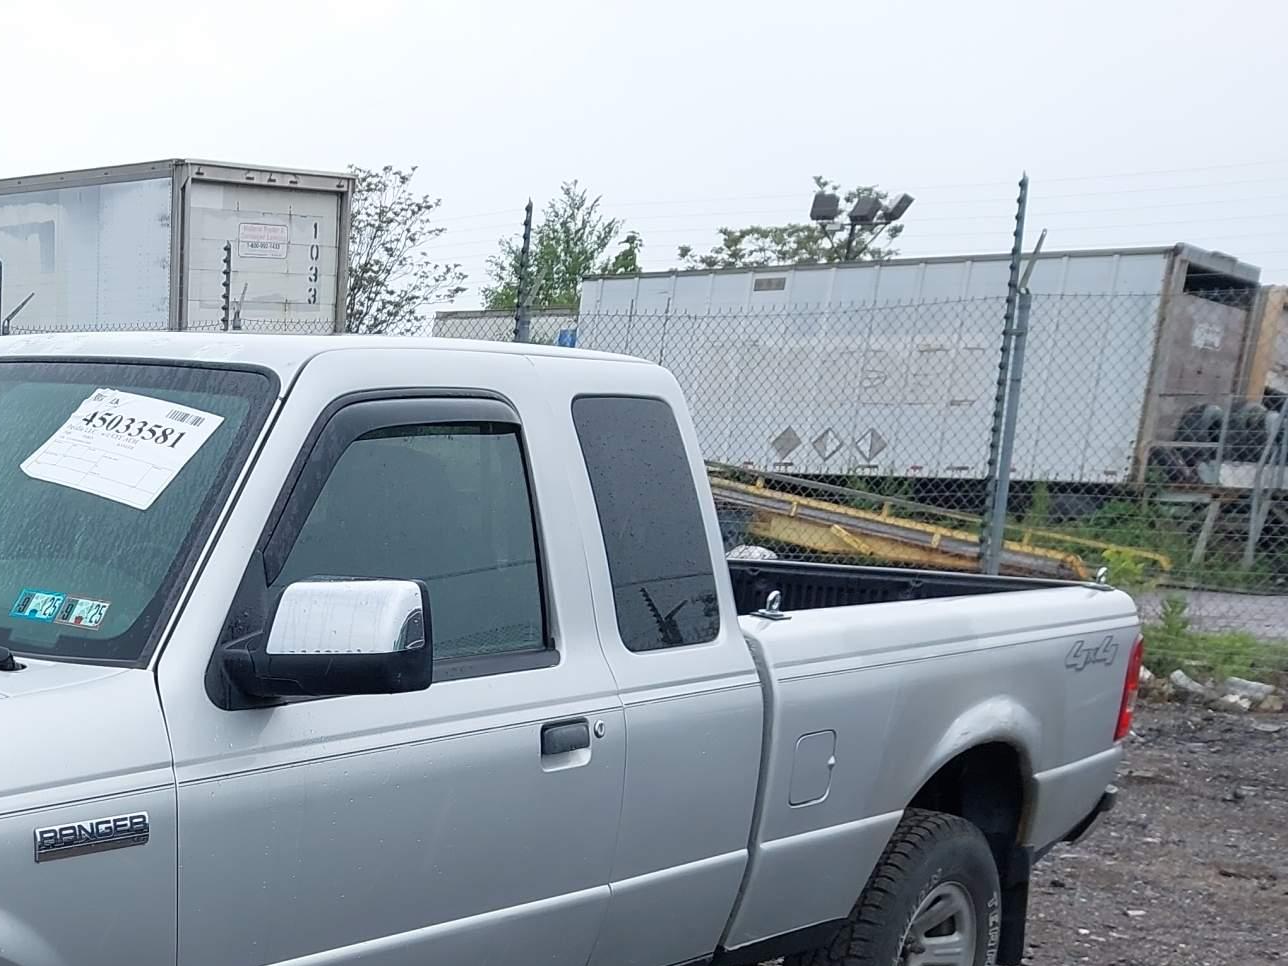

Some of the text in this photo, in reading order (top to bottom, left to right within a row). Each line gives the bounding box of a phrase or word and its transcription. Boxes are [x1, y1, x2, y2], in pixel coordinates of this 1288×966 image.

[82, 410, 187, 448] 45033581
[1064, 635, 1120, 672] 4x4
[38, 813, 150, 851] RANGER
